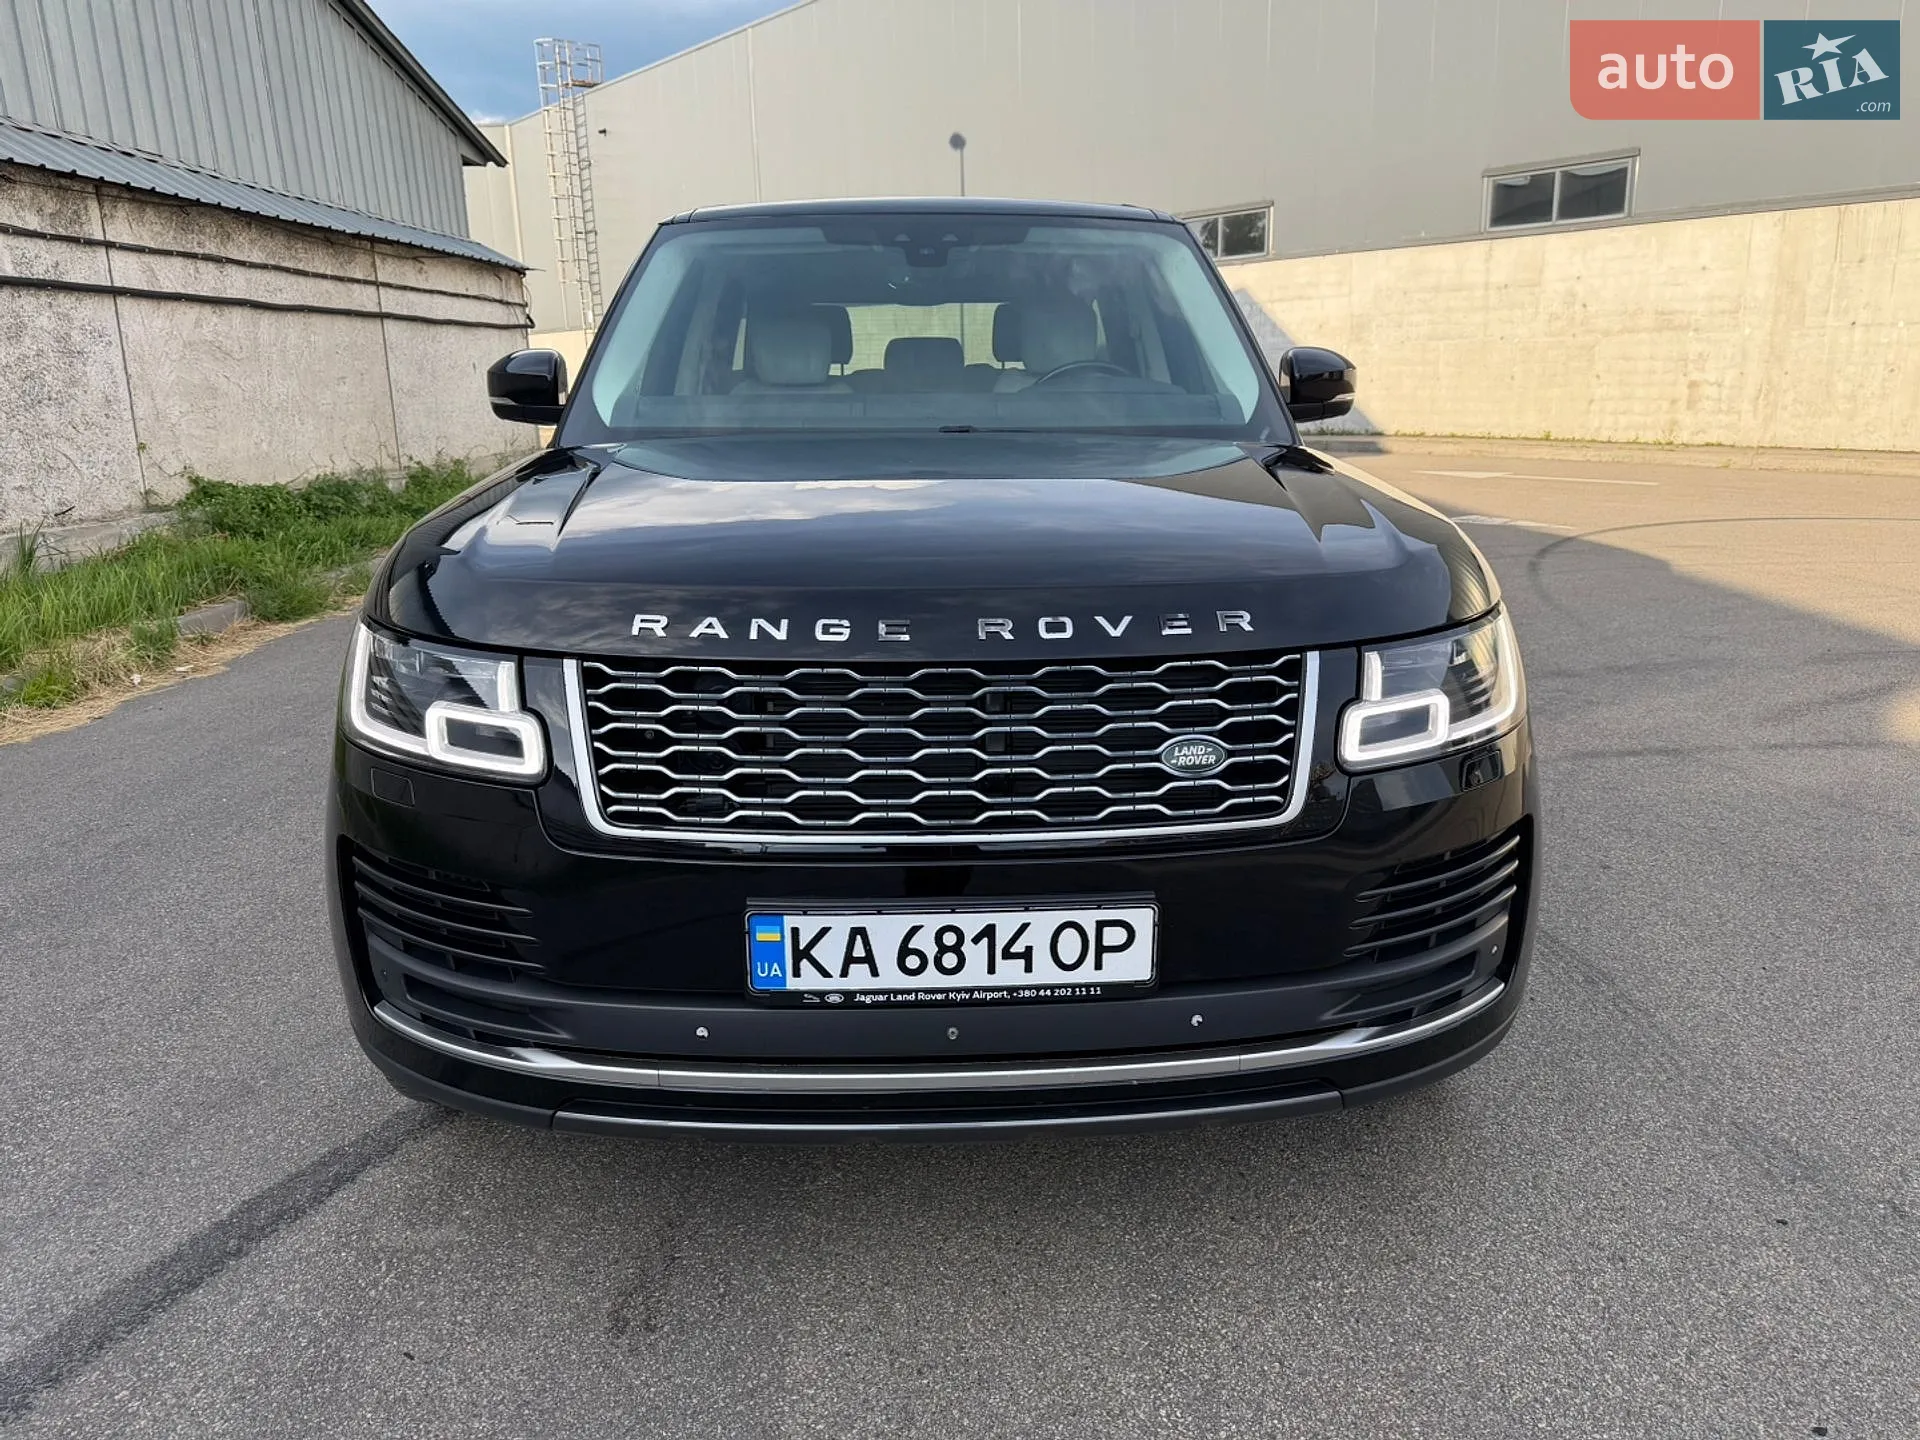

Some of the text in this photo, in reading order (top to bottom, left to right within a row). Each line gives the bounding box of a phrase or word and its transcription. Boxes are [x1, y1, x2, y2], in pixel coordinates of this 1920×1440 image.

[631, 609, 1255, 642] RANGE ROVER
[790, 918, 1136, 979] KA 6814 OP
[757, 961, 783, 978] UA
[853, 993, 887, 1004] Jaguar
[890, 992, 915, 1001] Land
[917, 991, 946, 1001] Rover
[949, 991, 969, 1002] Kyiv
[972, 989, 1010, 1000] Airport,
[1013, 988, 1037, 998] +380
[1038, 988, 1051, 997] 44
[1053, 987, 1072, 997] 202
[1075, 986, 1086, 996] 11
[1090, 986, 1101, 995] 11
